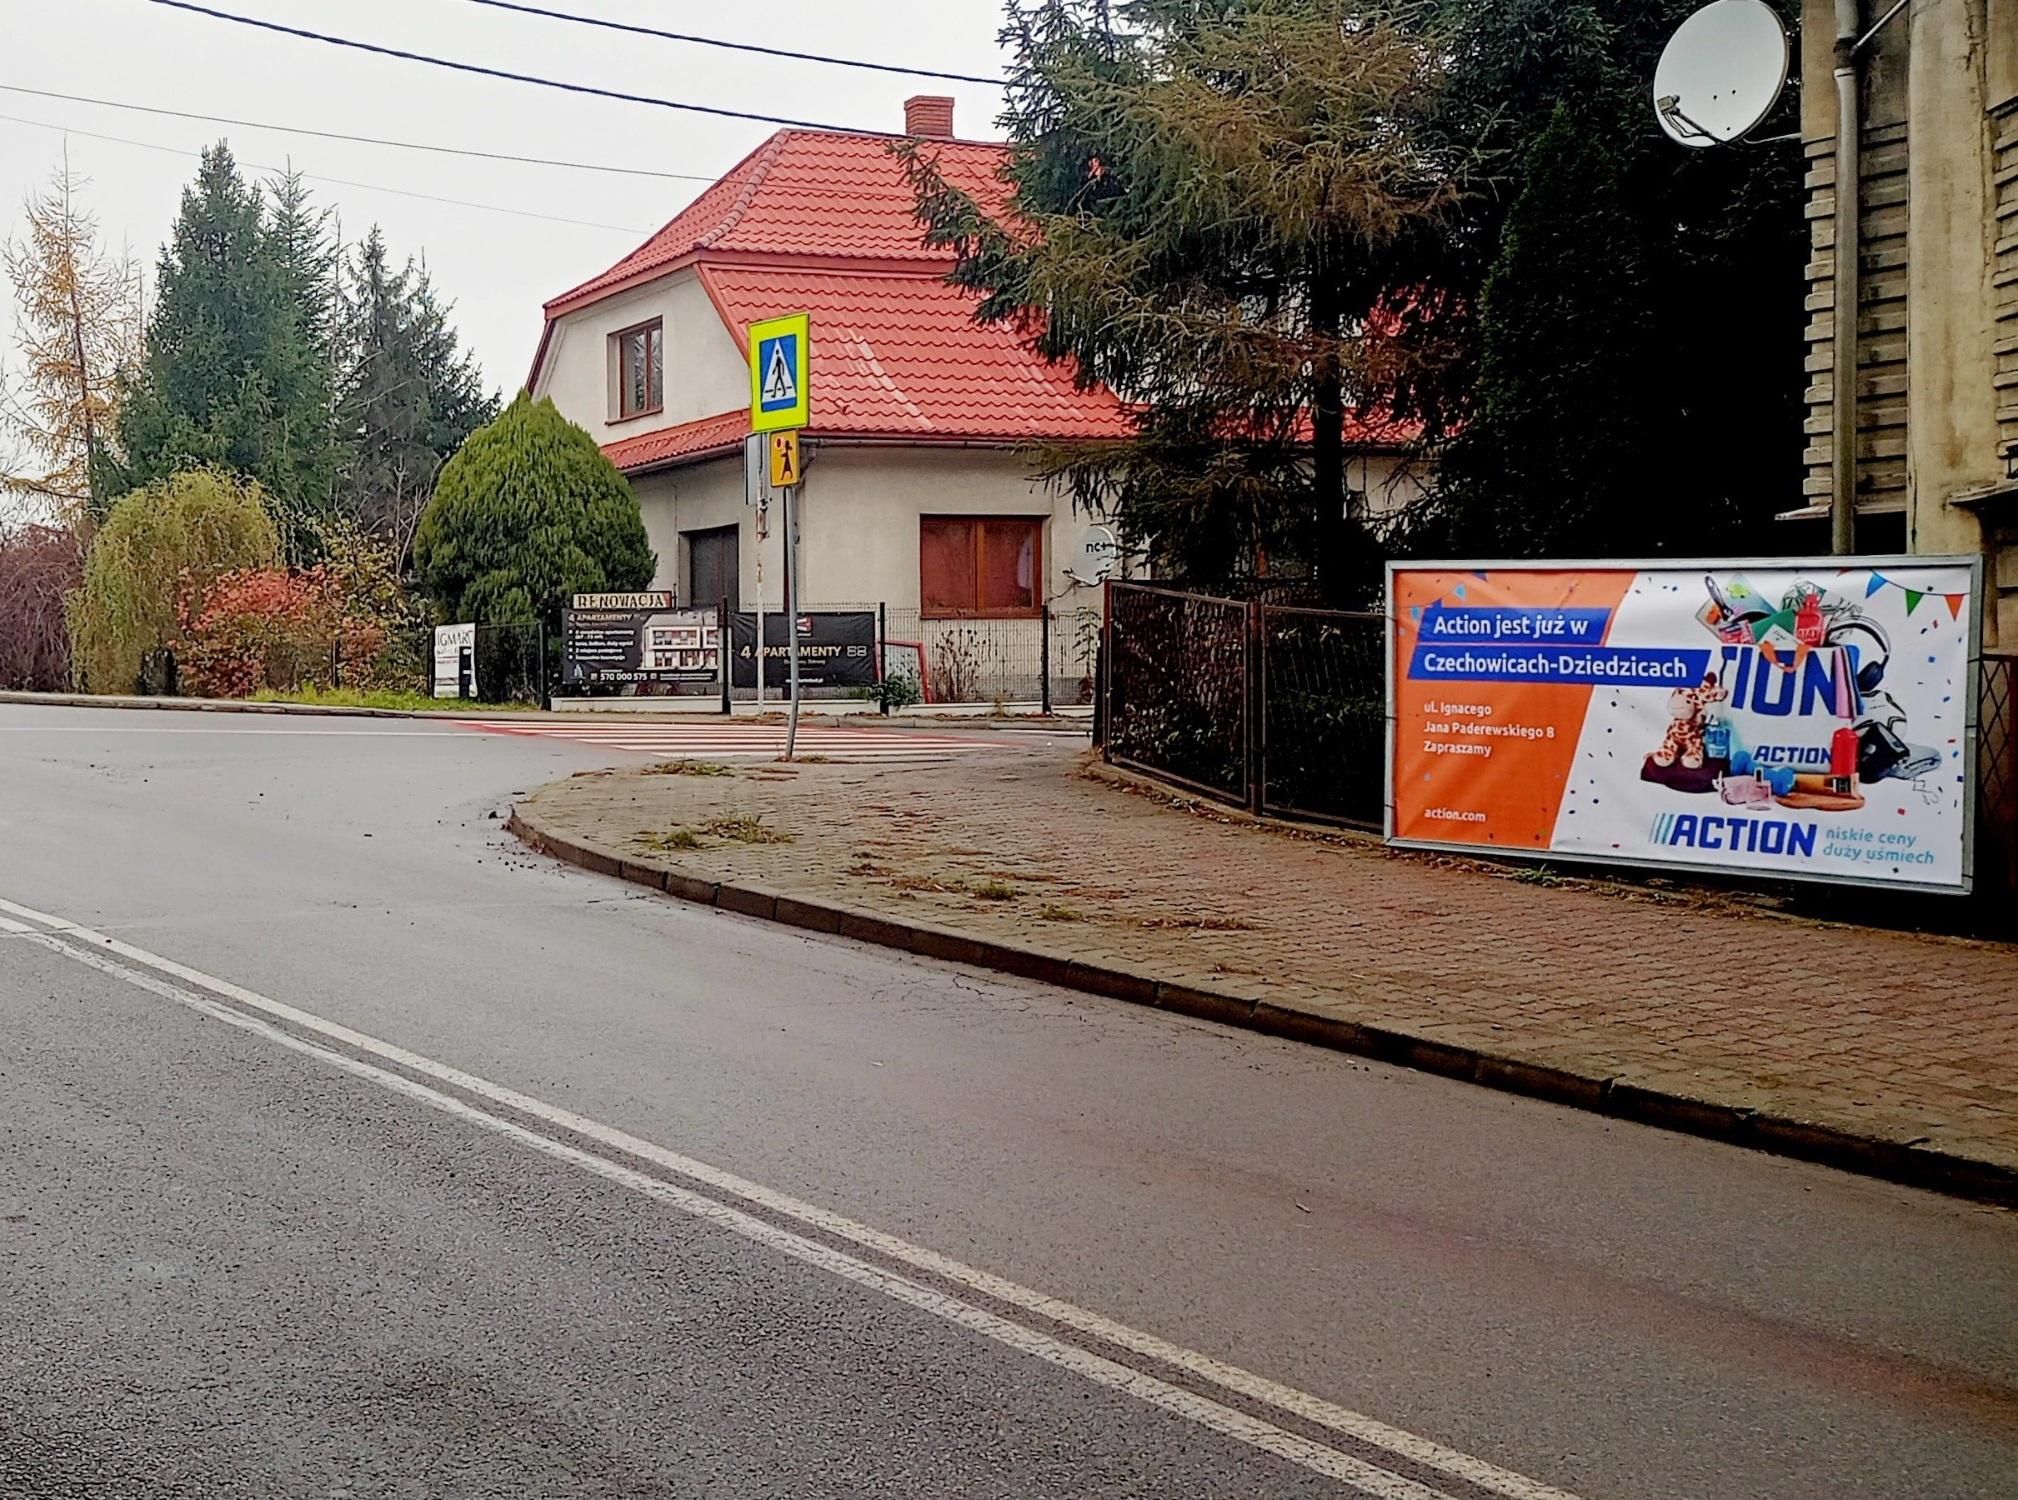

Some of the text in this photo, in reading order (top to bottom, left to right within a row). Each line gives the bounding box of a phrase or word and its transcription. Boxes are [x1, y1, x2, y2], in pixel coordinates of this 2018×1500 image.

[577, 594, 665, 607] RENOWACJA
[1433, 614, 1589, 638] Action jest już w
[740, 645, 752, 658] 4
[1424, 652, 1688, 678] Czechowicach-Dziedzicach
[1424, 701, 1493, 717] ul. Ignacego
[1424, 722, 1555, 740] Jana Paderewskiego 8
[1423, 740, 1492, 757] Zapraszamy
[1753, 745, 1833, 764] ACTION
[1424, 807, 1487, 822] action.com
[1669, 814, 1917, 857] ACTION niskie ceny
[1823, 842, 1934, 865] duży uśmiech
